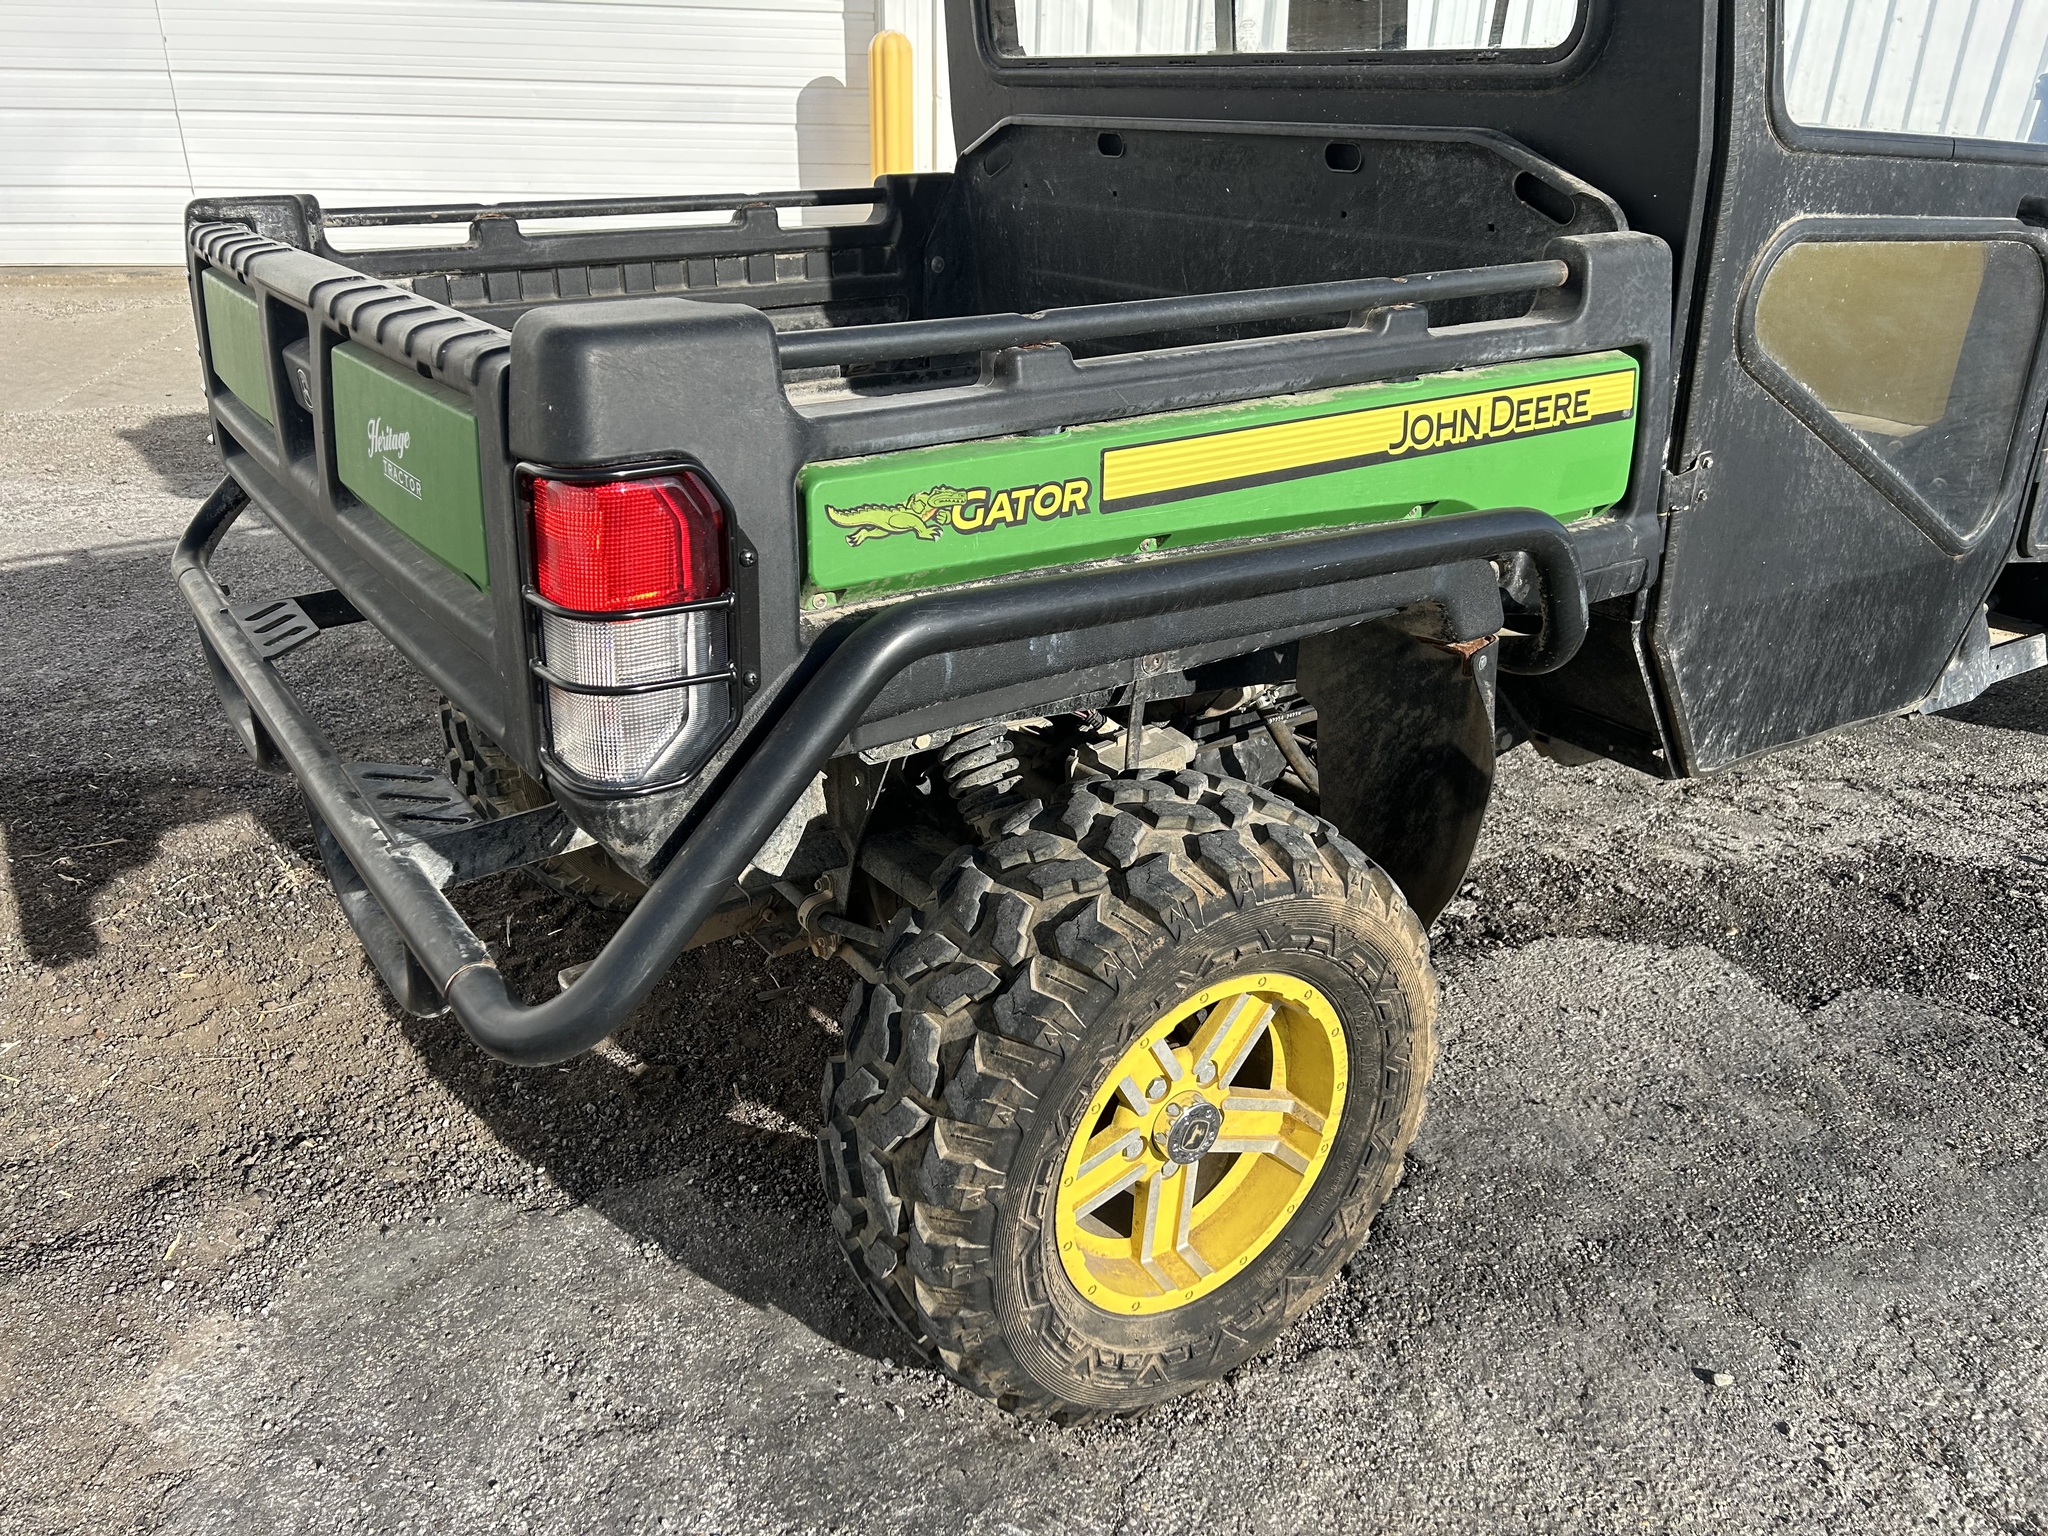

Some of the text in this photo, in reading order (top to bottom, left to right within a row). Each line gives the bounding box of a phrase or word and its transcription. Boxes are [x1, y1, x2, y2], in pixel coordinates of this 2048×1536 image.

[367, 416, 411, 459] Heritage
[1388, 388, 1591, 450] JOHN DEERE
[382, 459, 423, 497] TRACTOR
[951, 478, 1091, 533] GATOR
